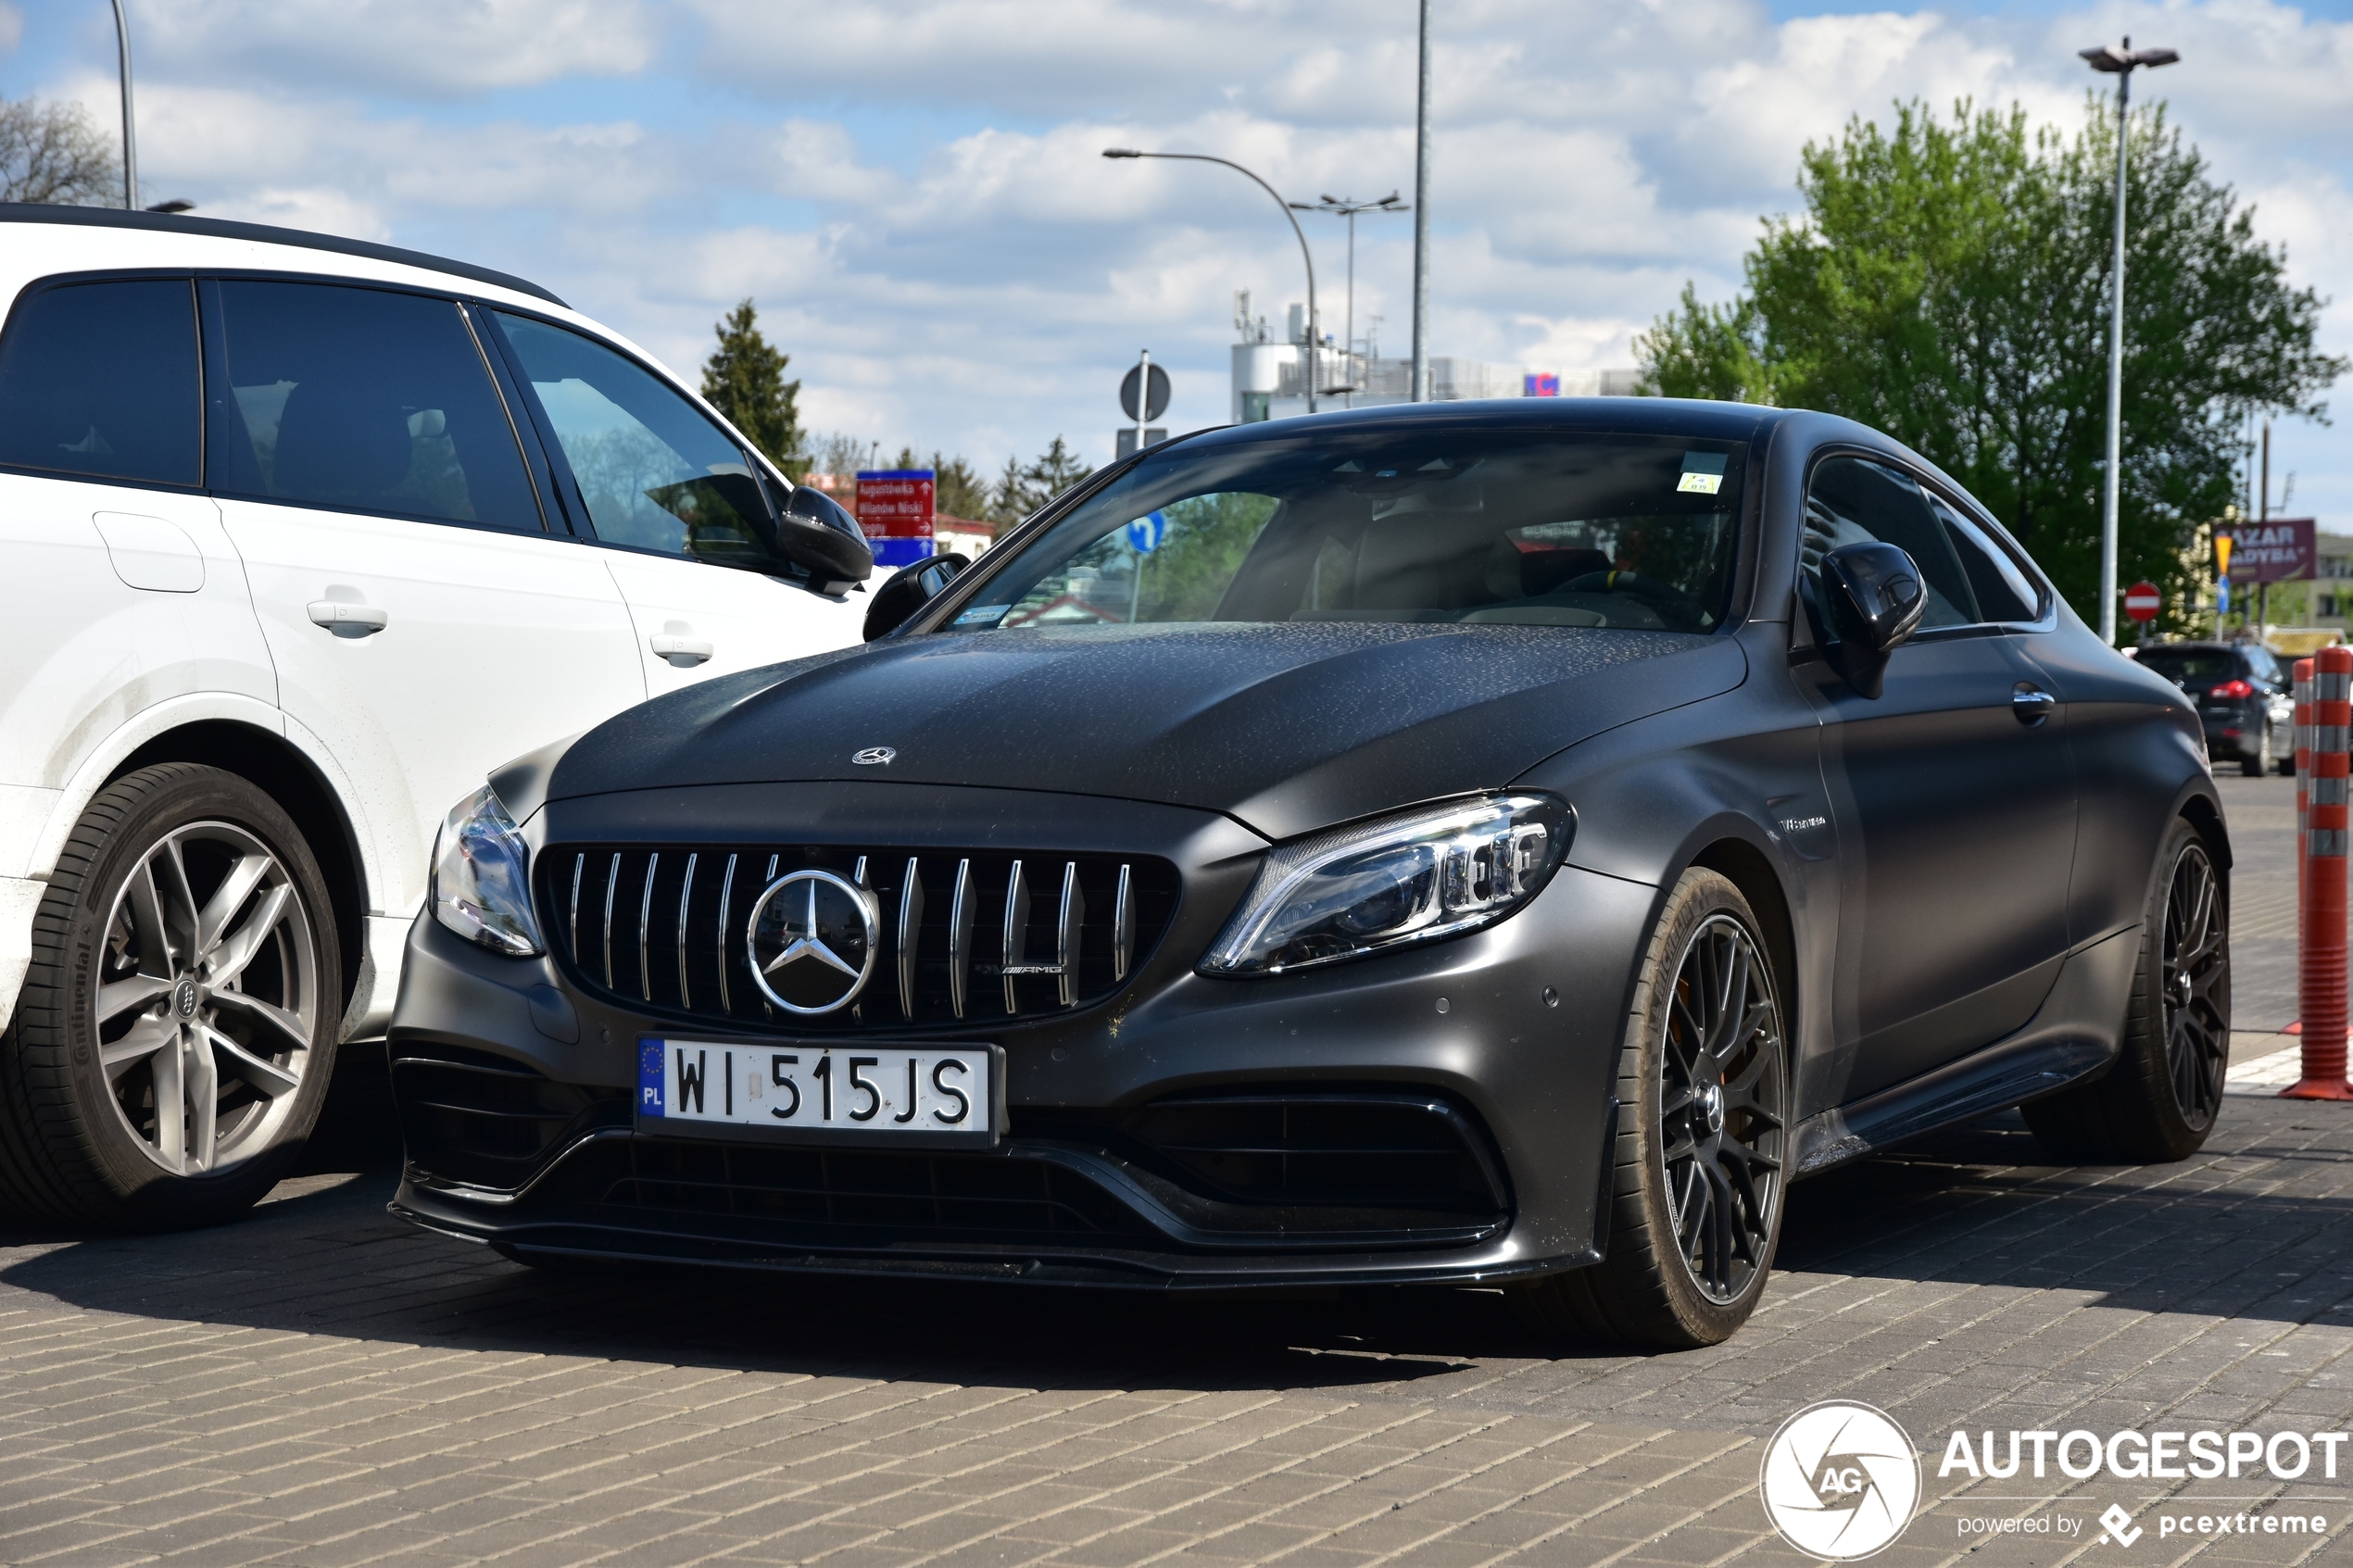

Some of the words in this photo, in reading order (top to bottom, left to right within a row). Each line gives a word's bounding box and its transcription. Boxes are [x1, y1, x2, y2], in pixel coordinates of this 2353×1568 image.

[859, 482, 915, 498] Augustówka
[859, 501, 896, 515] Wilanów
[897, 501, 924, 515] Niski
[2216, 526, 2295, 547] AZAR
[1654, 902, 1694, 998] MICHELIN
[70, 941, 92, 1066] Continental
[643, 1086, 662, 1107] PL
[676, 1047, 733, 1117] WI
[771, 1053, 971, 1125] 515JS
